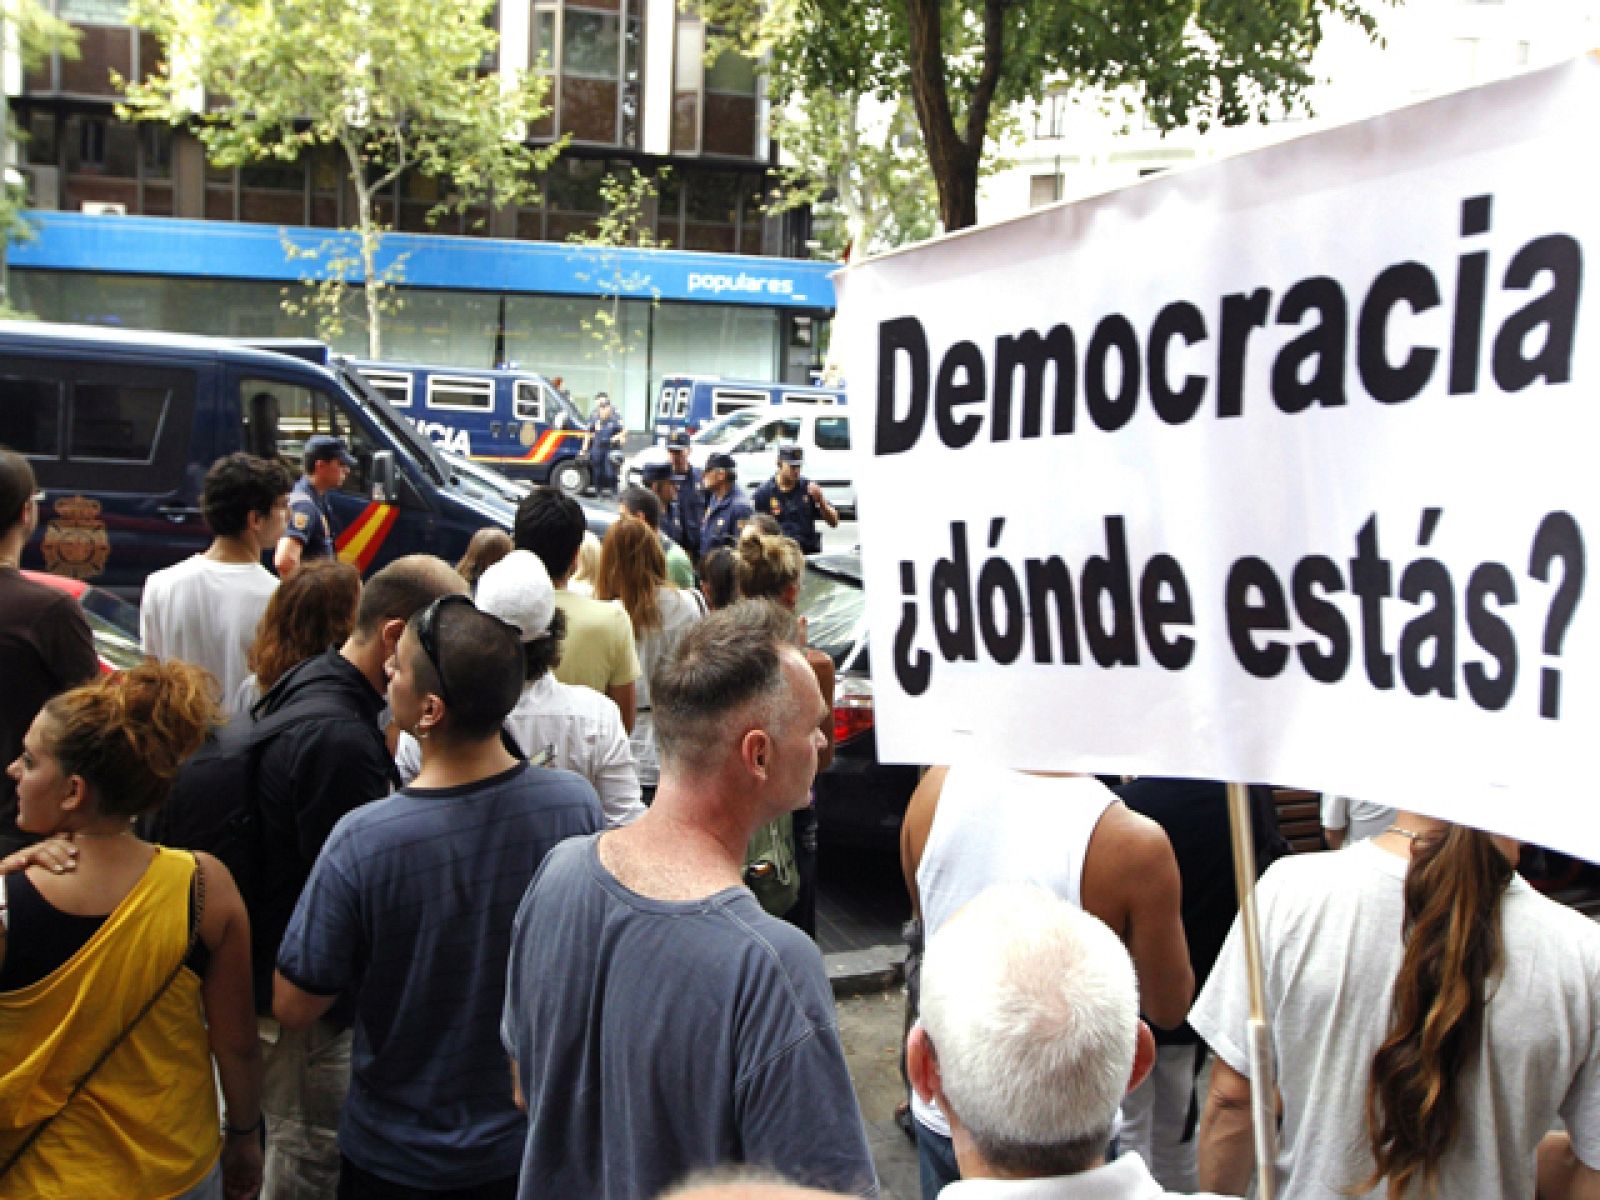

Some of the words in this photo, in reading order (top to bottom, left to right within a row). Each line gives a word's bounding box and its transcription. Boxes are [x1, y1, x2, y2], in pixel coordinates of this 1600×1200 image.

[874, 194, 1584, 457] Democracia
[893, 513, 1197, 697] ¿dónde
[1224, 507, 1587, 721] estás?
